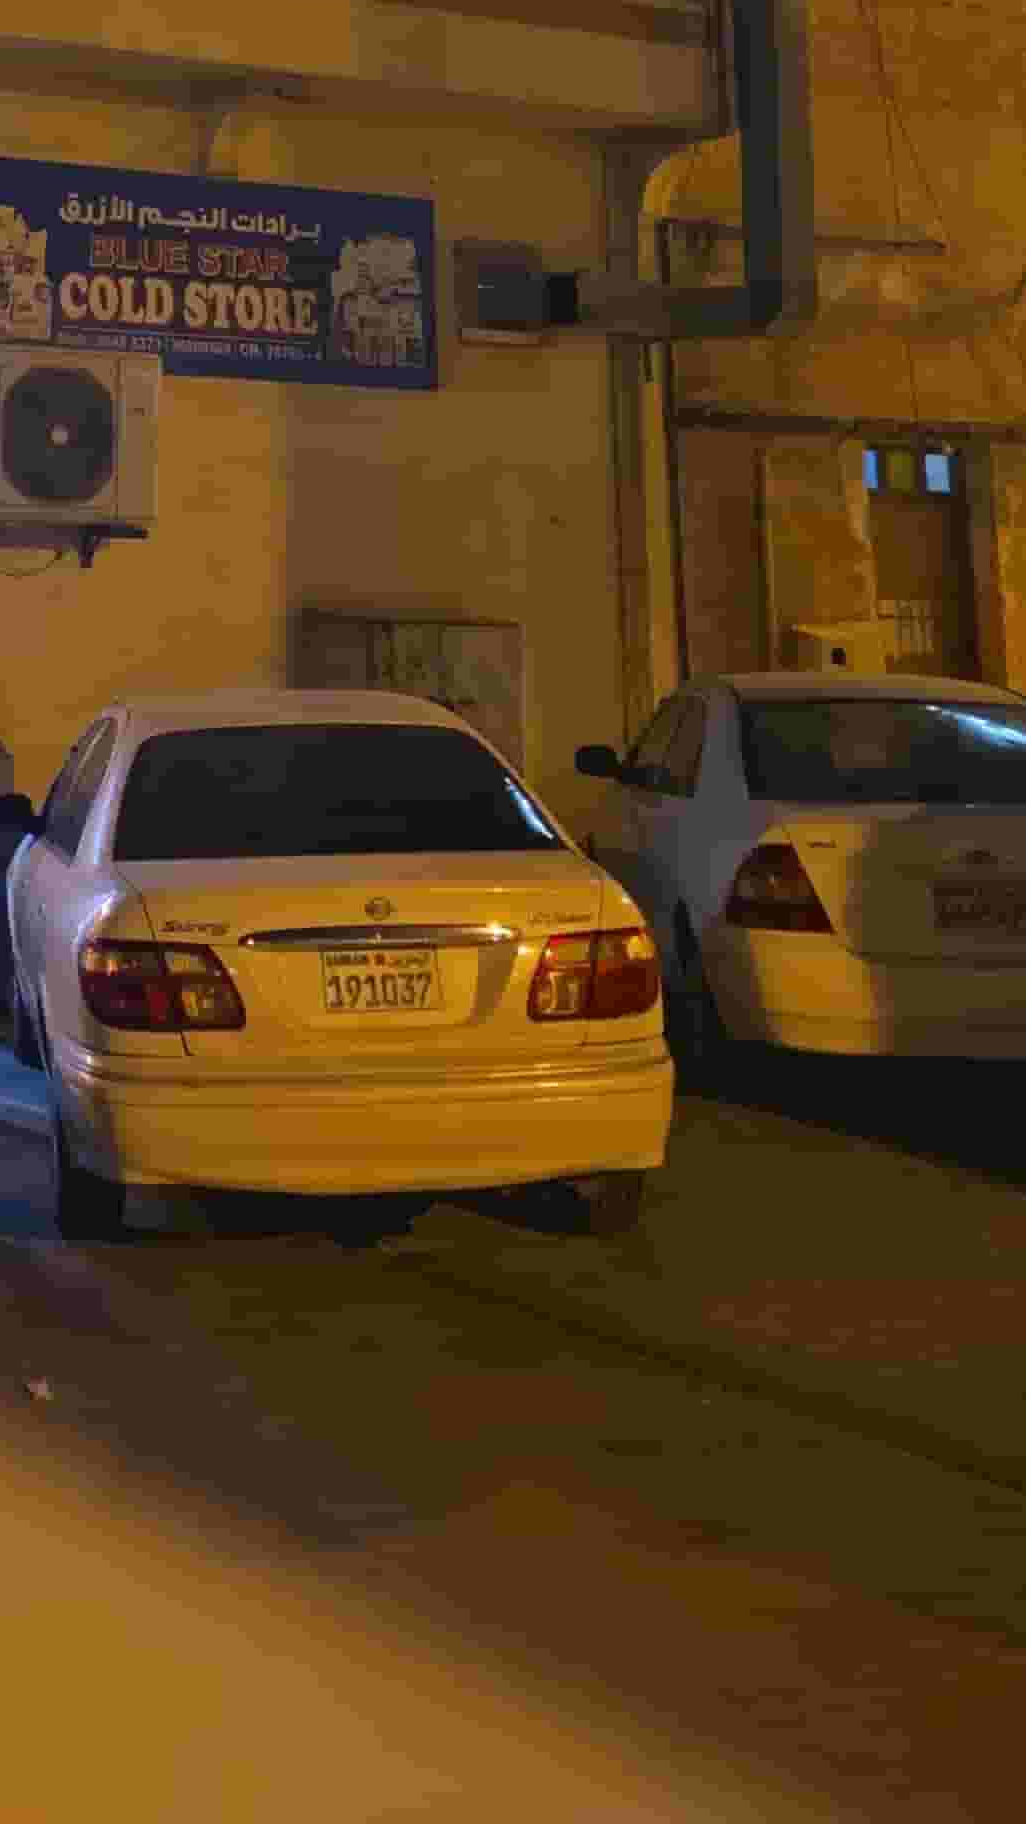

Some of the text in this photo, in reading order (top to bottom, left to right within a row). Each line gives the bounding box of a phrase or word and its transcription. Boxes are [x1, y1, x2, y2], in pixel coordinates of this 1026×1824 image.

[90, 233, 293, 283] BLUE STAR
[59, 271, 320, 336] COLD STORE
[327, 972, 432, 1009] 191037
